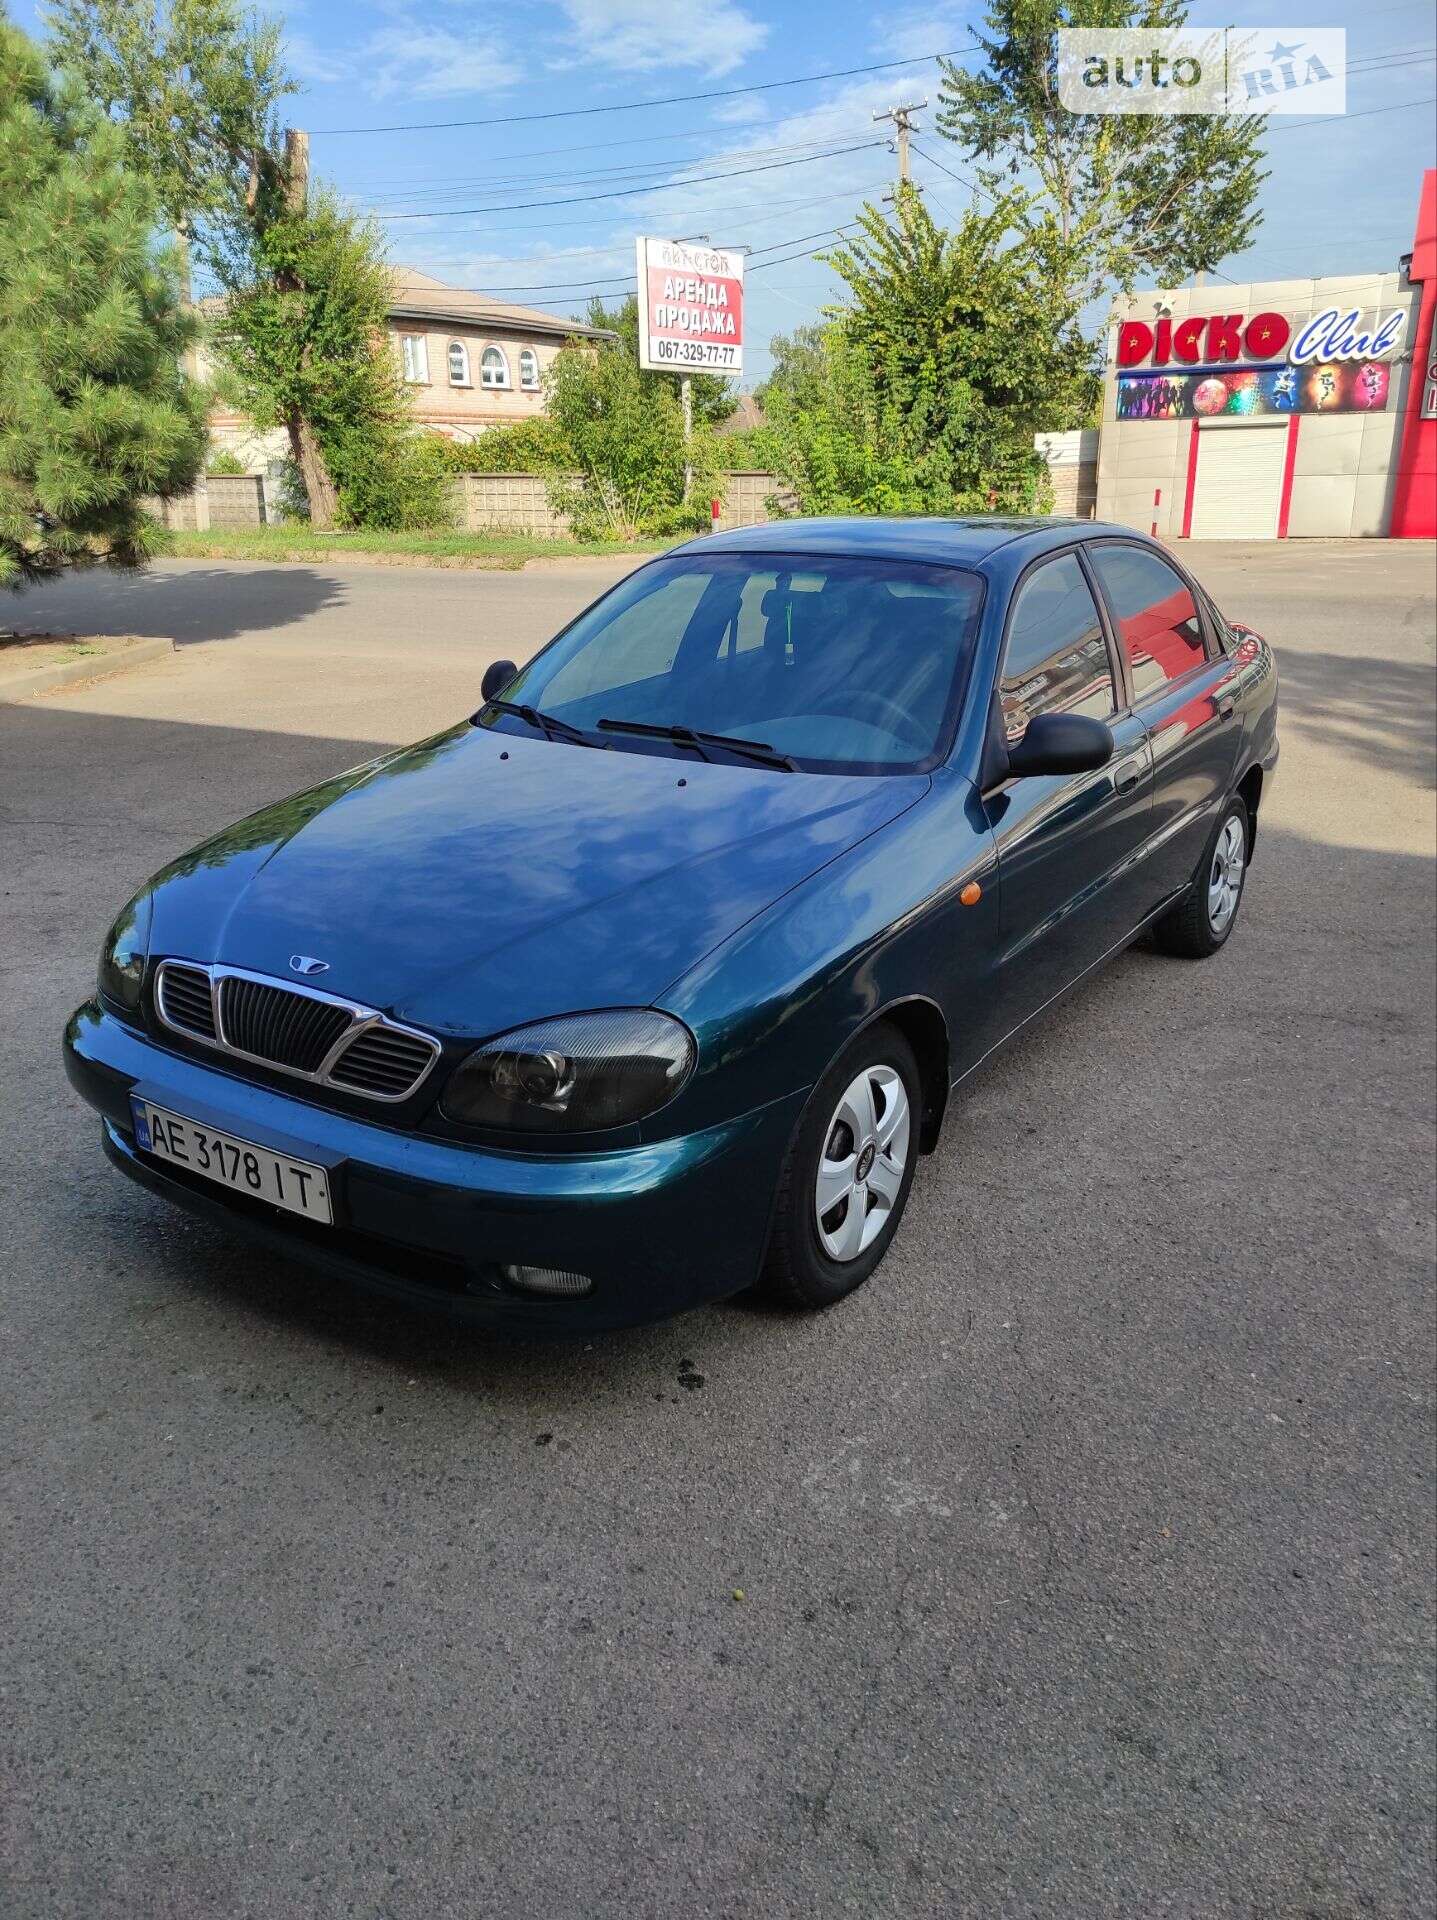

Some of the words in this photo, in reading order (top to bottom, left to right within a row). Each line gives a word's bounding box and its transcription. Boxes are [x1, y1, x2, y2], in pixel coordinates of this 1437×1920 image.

[664, 276, 728, 310] АРЕНДА
[655, 304, 736, 335] ПРОДАЖА
[1291, 307, 1407, 364] Club
[658, 340, 735, 364] 067-329-77-77
[138, 1128, 150, 1143] UA
[152, 1114, 190, 1162] AE
[193, 1130, 262, 1190] 3178
[274, 1161, 312, 1208] IT
